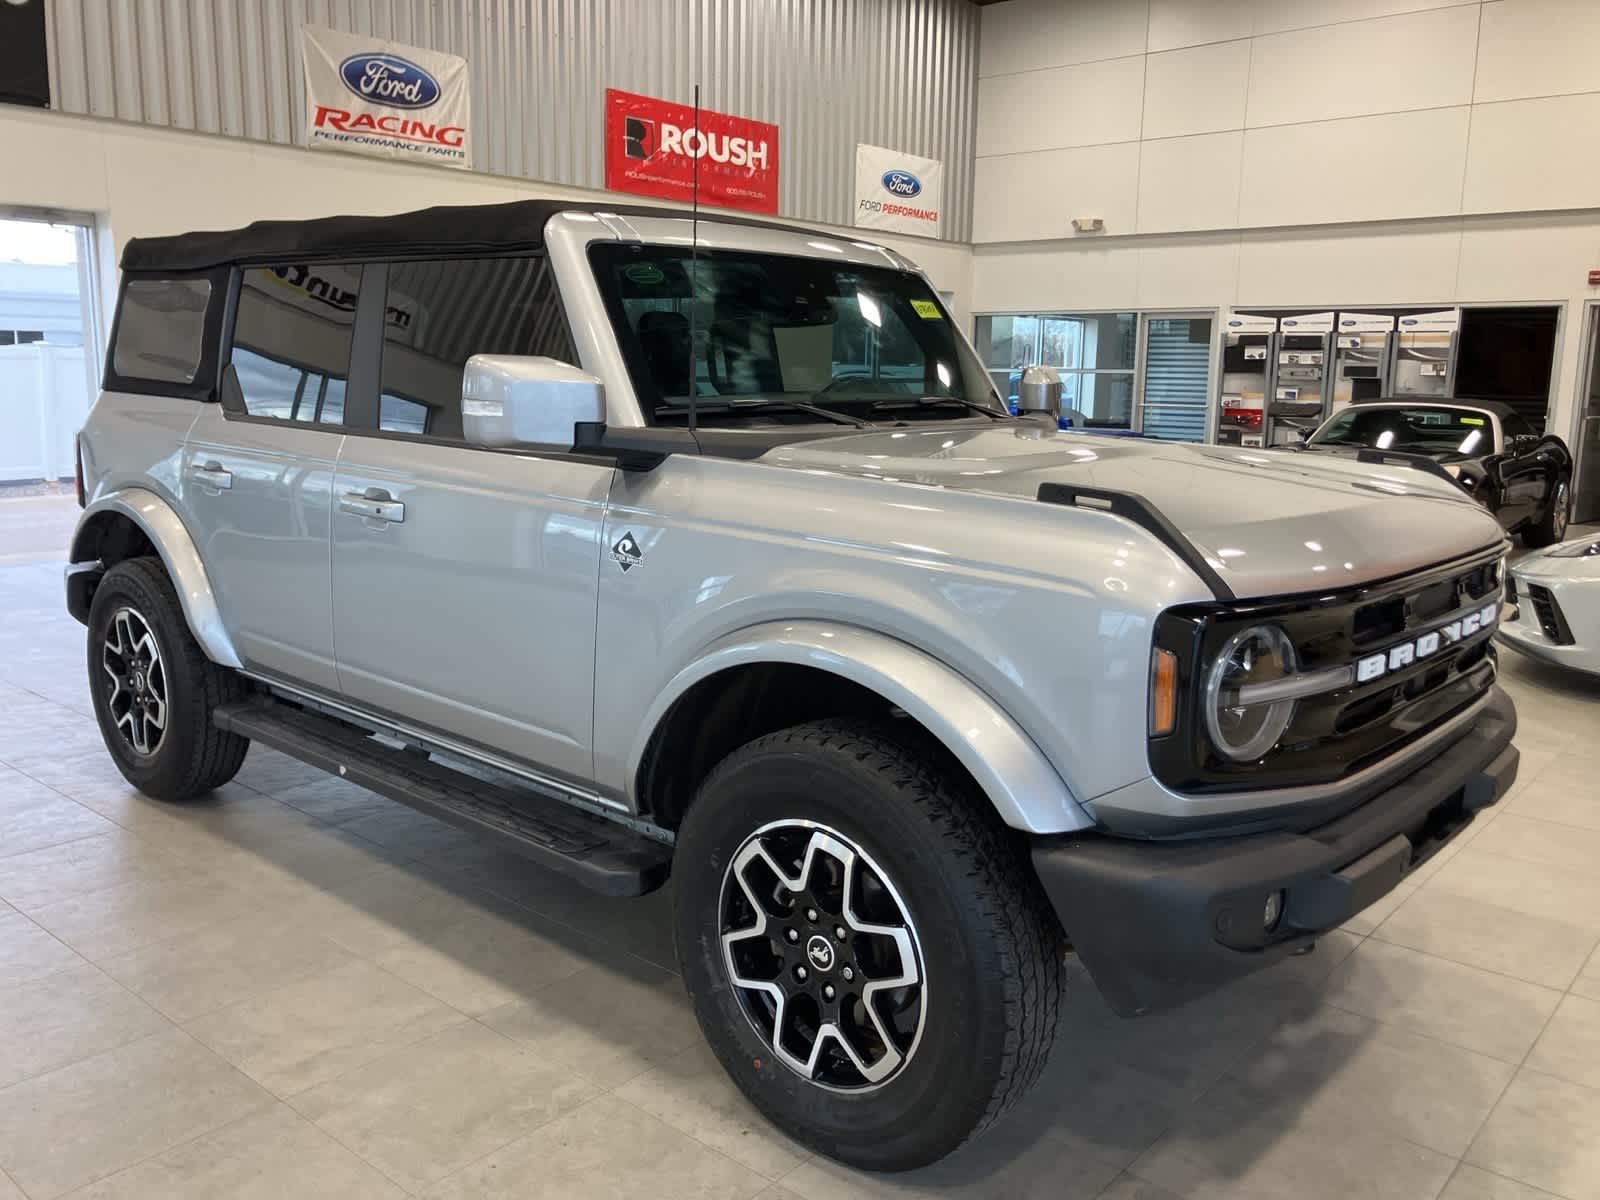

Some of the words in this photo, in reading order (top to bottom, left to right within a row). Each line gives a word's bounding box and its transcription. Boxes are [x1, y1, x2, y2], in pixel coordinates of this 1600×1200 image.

[360, 60, 422, 102] Ford
[313, 105, 465, 147] RACING
[314, 130, 424, 152] PERFORMANCE
[426, 146, 465, 158] PARTS
[660, 123, 768, 170] ROUSH
[889, 174, 914, 194] Ford
[859, 200, 881, 212] FORD
[1357, 603, 1497, 683] BRONCO
